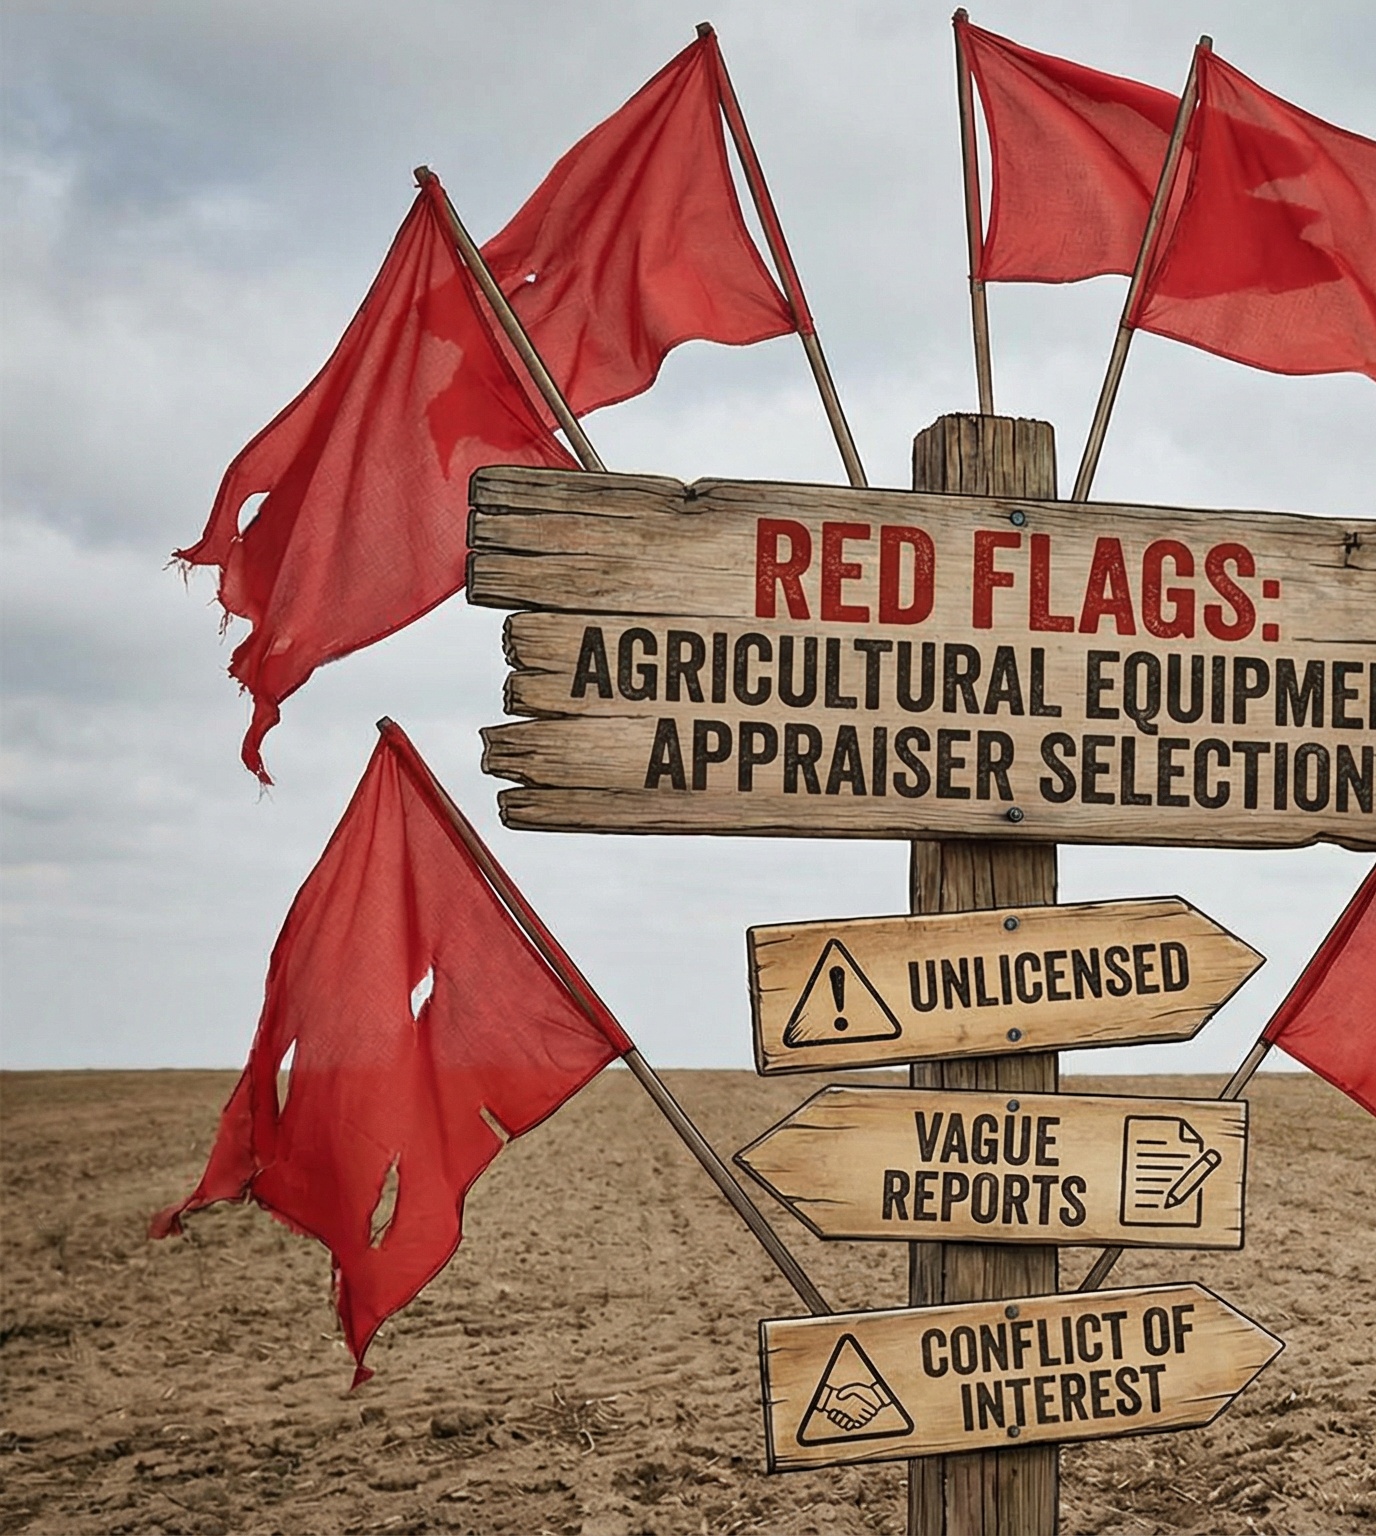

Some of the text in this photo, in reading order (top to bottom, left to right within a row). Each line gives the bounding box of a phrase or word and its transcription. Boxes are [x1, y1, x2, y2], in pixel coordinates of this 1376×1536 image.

[755, 517, 1281, 642] RED FLAGS:
[570, 626, 1061, 717] AGRICULTURAL
[644, 717, 1374, 814] APPRAISER SELECTION
[908, 941, 1189, 1012] UNLICENSED
[914, 1111, 1061, 1167] VAGUE
[882, 1170, 1087, 1227] REPORTS
[921, 1304, 1195, 1378] CONFLICT OF
[960, 1364, 1166, 1432] INTEREST
